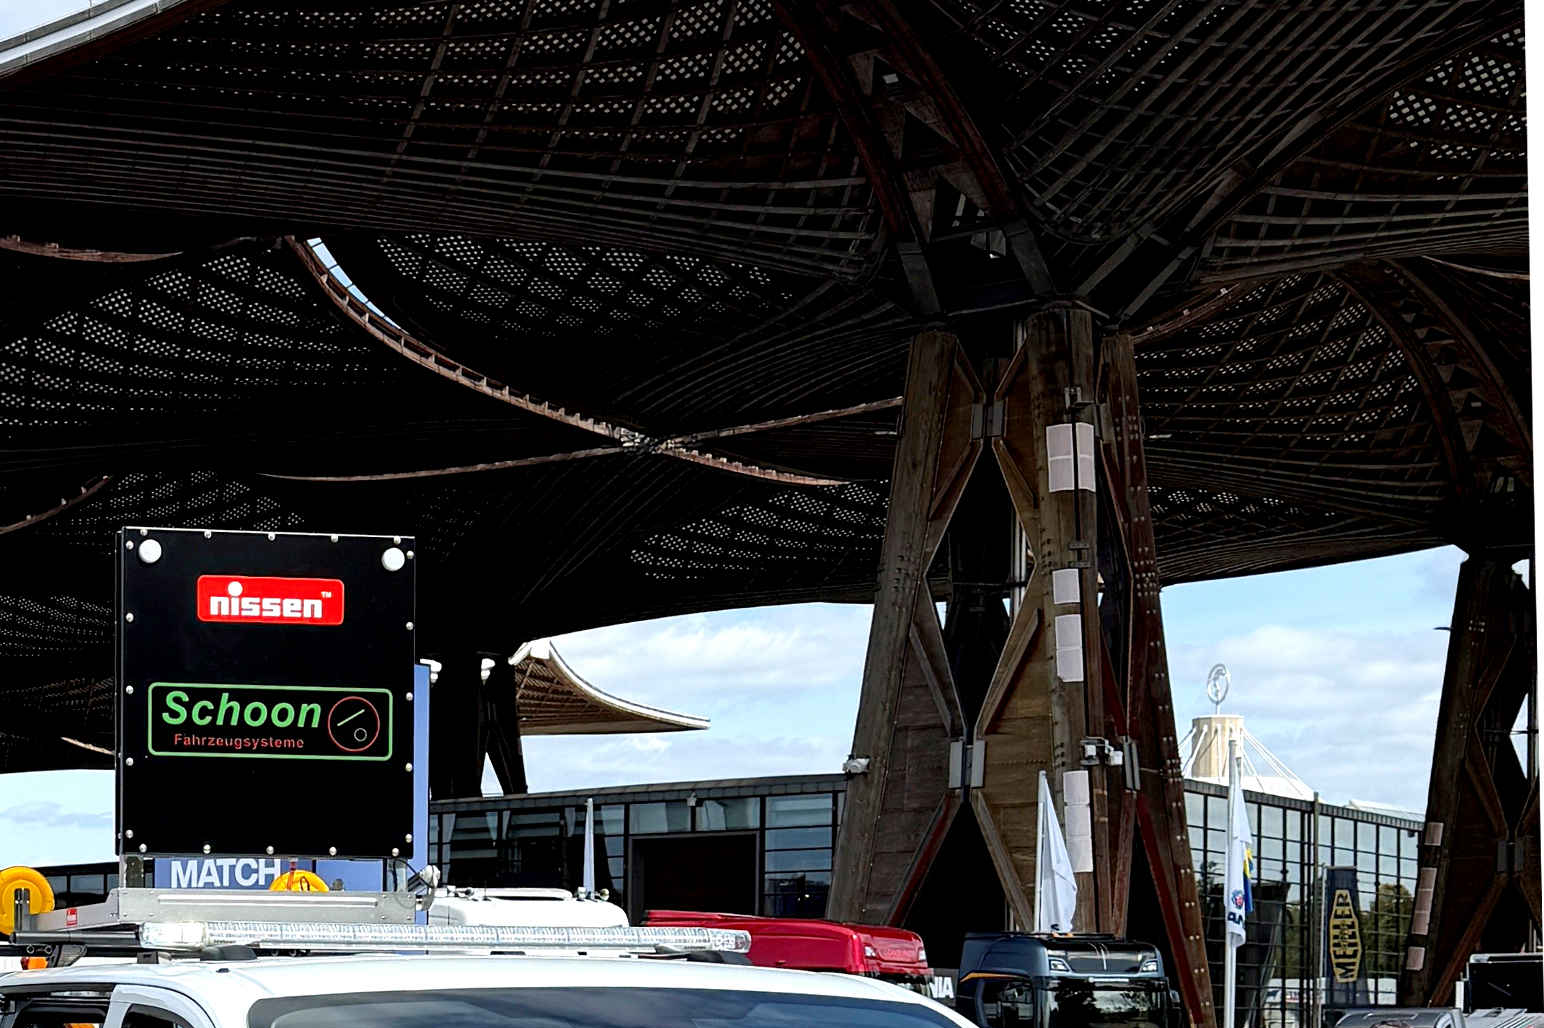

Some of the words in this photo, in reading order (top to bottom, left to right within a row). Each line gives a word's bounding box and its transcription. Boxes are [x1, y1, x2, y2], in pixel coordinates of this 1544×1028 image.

[162, 690, 322, 729] Schoon
[173, 732, 305, 750] Fahrzeugsysteme
[170, 858, 281, 888] MATCH
